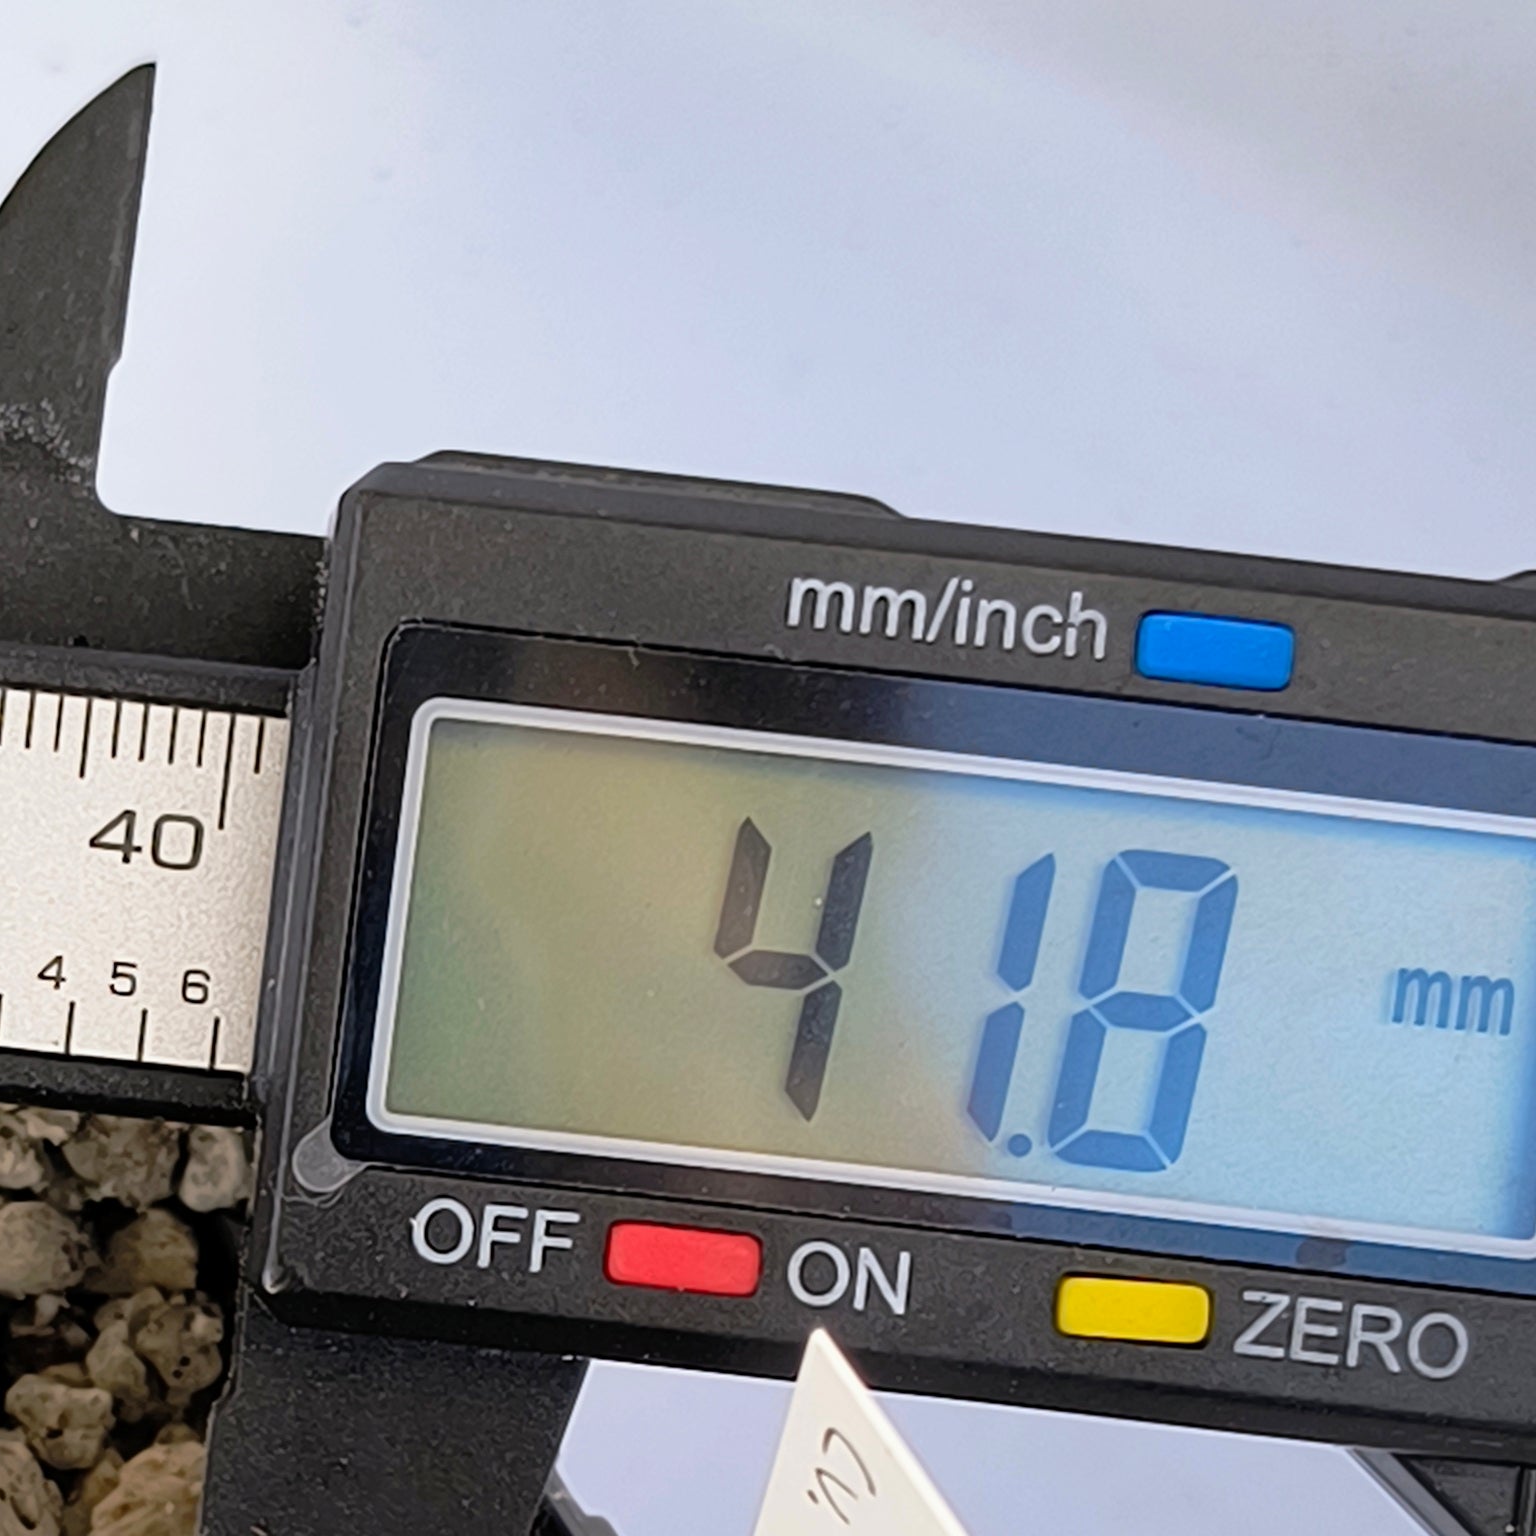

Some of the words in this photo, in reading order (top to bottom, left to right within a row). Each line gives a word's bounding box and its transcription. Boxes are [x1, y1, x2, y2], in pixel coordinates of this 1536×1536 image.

[786, 575, 1109, 661] mm/inch
[87, 808, 206, 872] 40
[36, 954, 67, 991] 4
[108, 960, 138, 998] 5
[180, 968, 212, 1006] 6
[713, 816, 1238, 1172] 41.8
[1390, 966, 1515, 1037] mm
[408, 1197, 582, 1274] OFF
[786, 1240, 912, 1316] ON
[1232, 1289, 1470, 1380] ZERO
